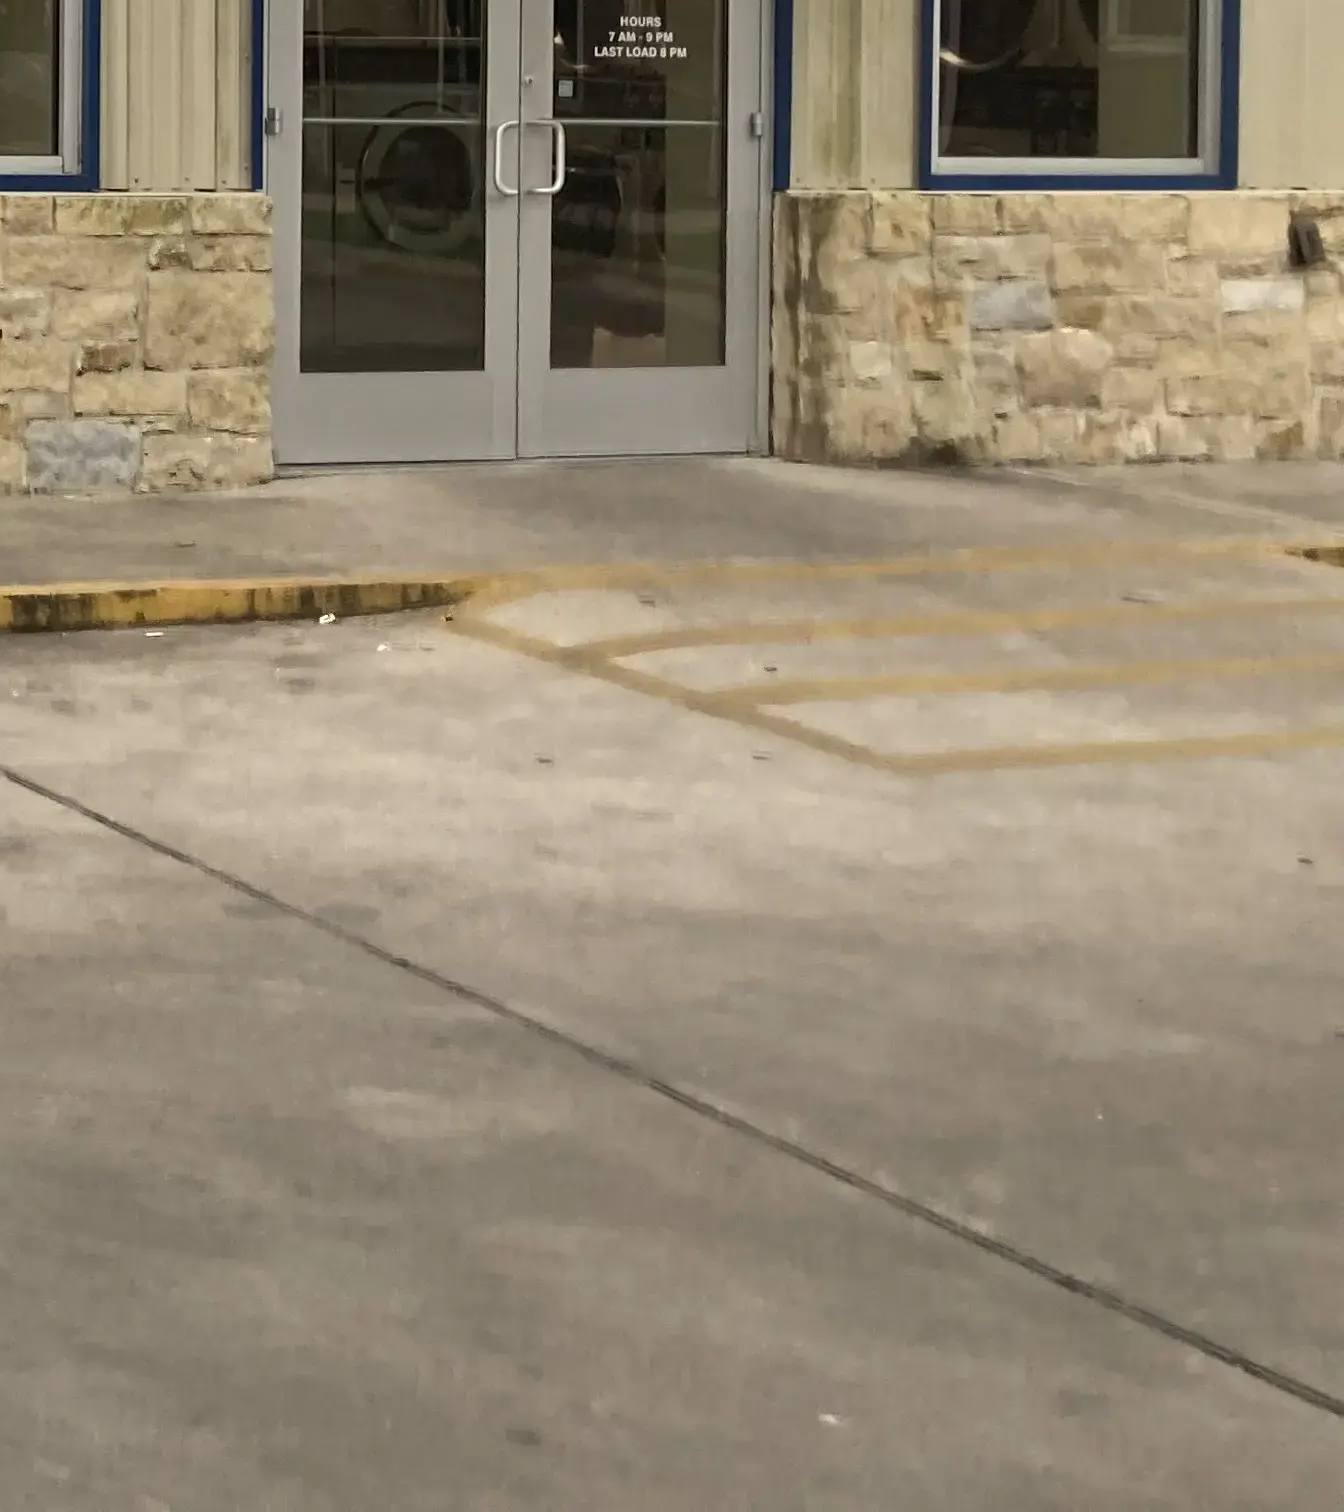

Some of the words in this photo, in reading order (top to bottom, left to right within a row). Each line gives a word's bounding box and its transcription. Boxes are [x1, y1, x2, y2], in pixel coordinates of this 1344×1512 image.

[619, 16, 662, 28] HOURS
[608, 31, 616, 42] 7
[618, 31, 636, 43] AM
[645, 32, 653, 43] 9
[655, 31, 674, 43] PM
[594, 46, 623, 58] LAST
[625, 46, 657, 58] LOAD
[669, 47, 688, 58] PM
